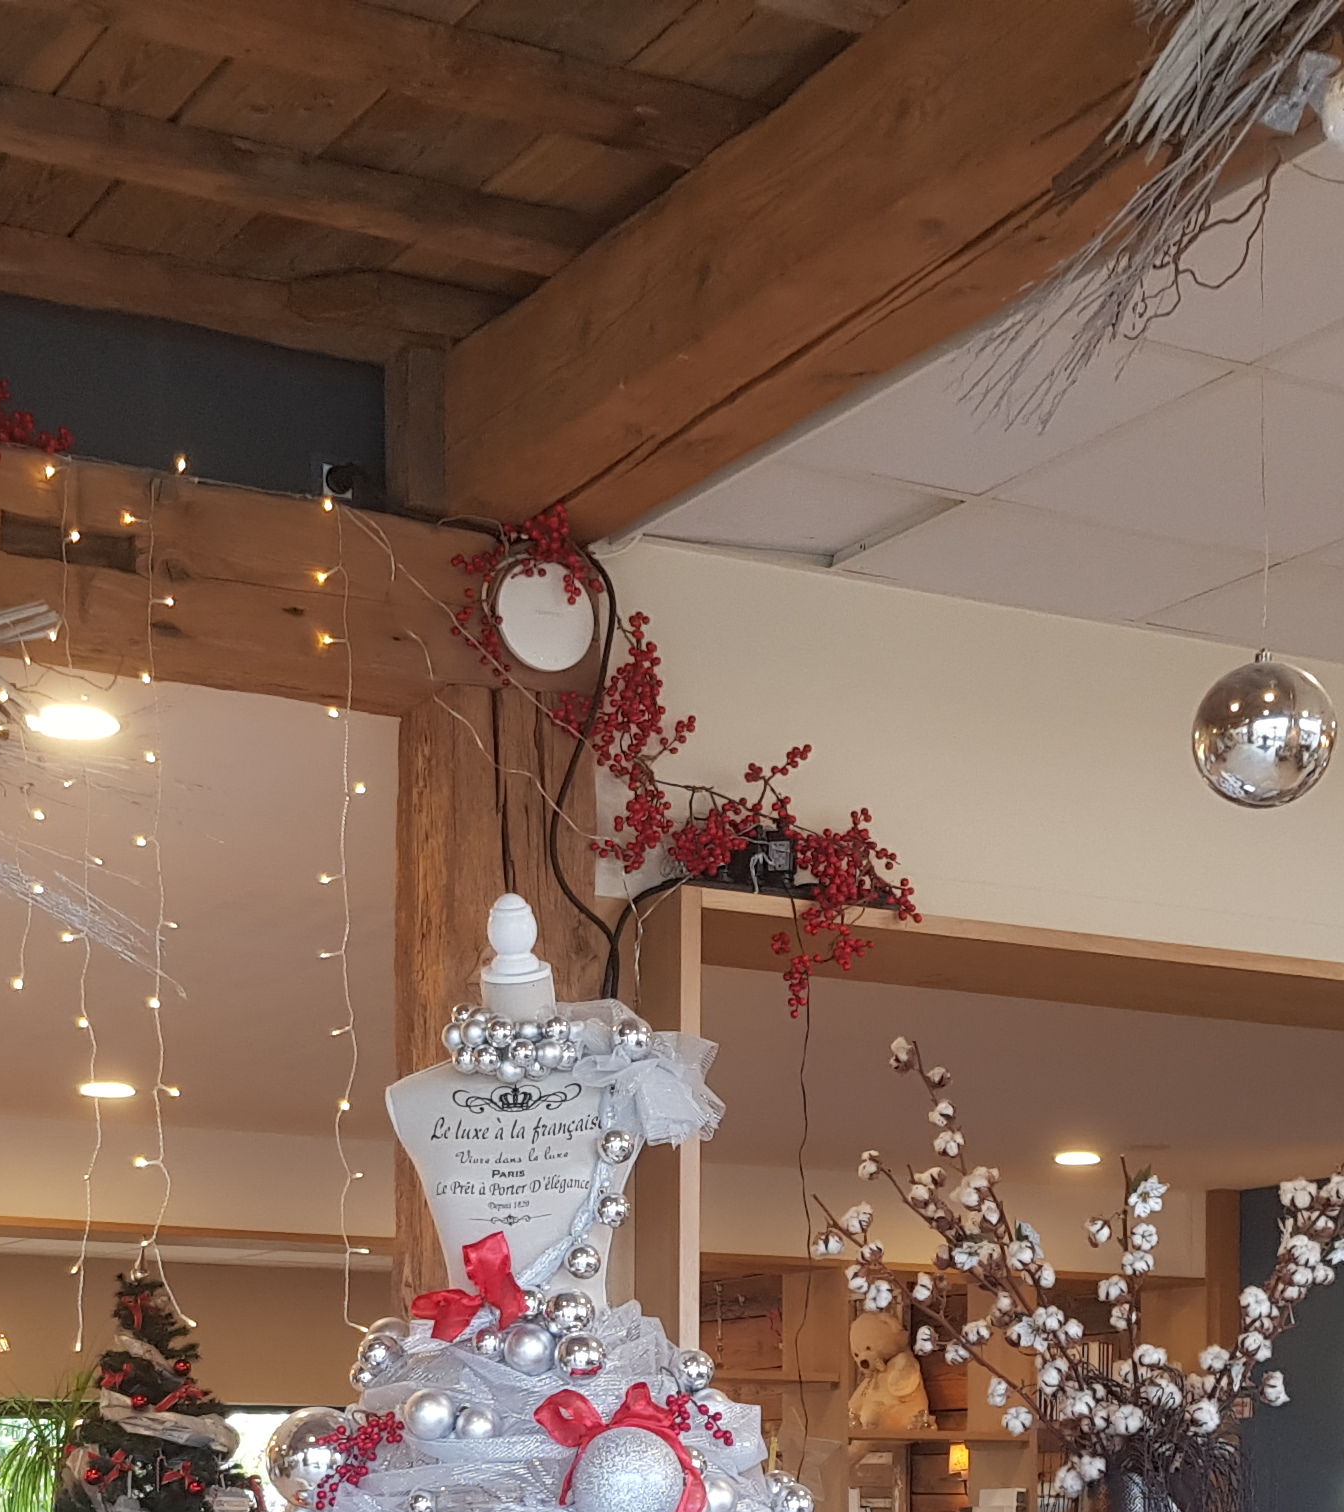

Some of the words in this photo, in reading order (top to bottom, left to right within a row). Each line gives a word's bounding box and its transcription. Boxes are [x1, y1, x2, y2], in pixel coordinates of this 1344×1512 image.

[431, 1117, 451, 1140] Le
[456, 1119, 490, 1140] luxe
[494, 1117, 504, 1140] à
[510, 1119, 525, 1140] la
[494, 1152, 523, 1164] dans
[528, 1147, 539, 1162] le
[544, 1146, 569, 1160] luxe
[491, 1169, 526, 1179] PARIS
[436, 1182, 448, 1195] Le
[450, 1181, 475, 1195] Prêt
[478, 1182, 486, 1195] à
[489, 1183, 527, 1196] Porter
